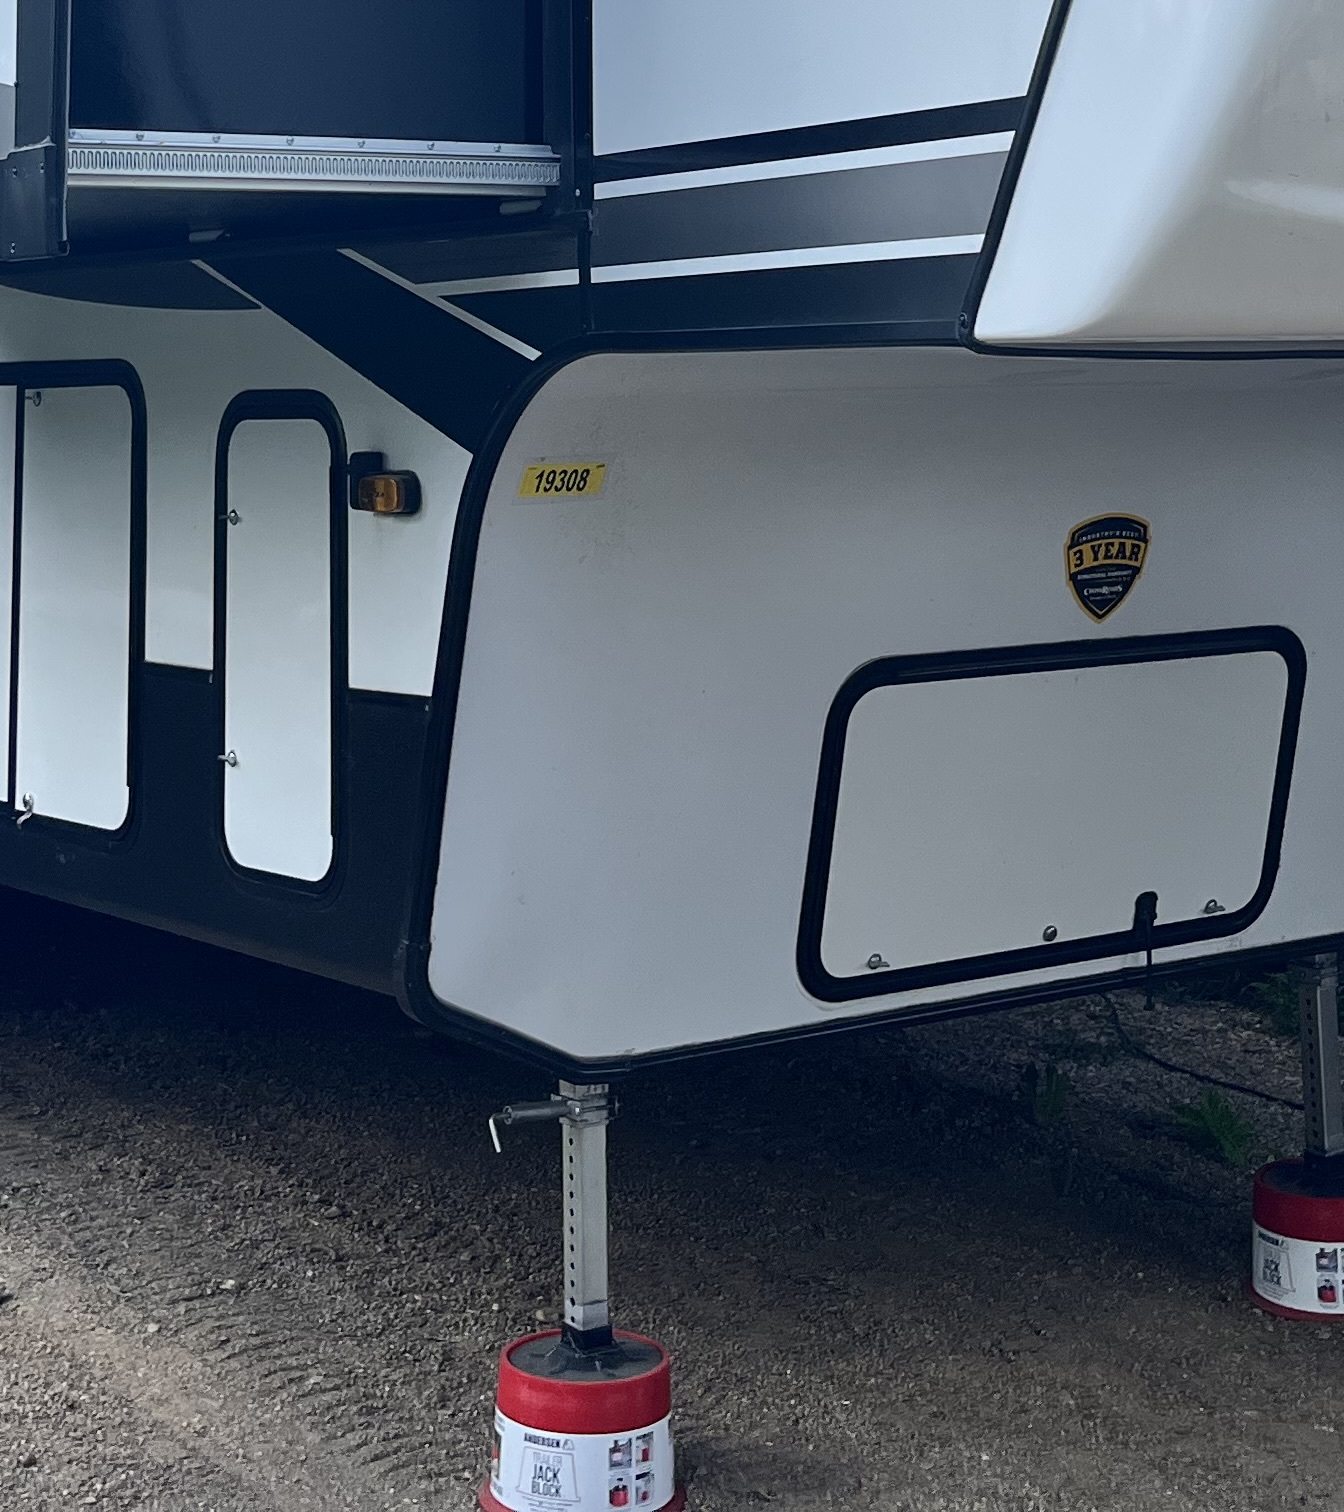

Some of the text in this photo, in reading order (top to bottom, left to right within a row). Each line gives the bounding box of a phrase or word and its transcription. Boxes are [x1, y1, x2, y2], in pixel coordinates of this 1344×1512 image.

[535, 469, 590, 493] 19308
[1073, 542, 1141, 568] 3 YEAR
[532, 1464, 561, 1484] JACK
[531, 1480, 562, 1498] BLOCK
